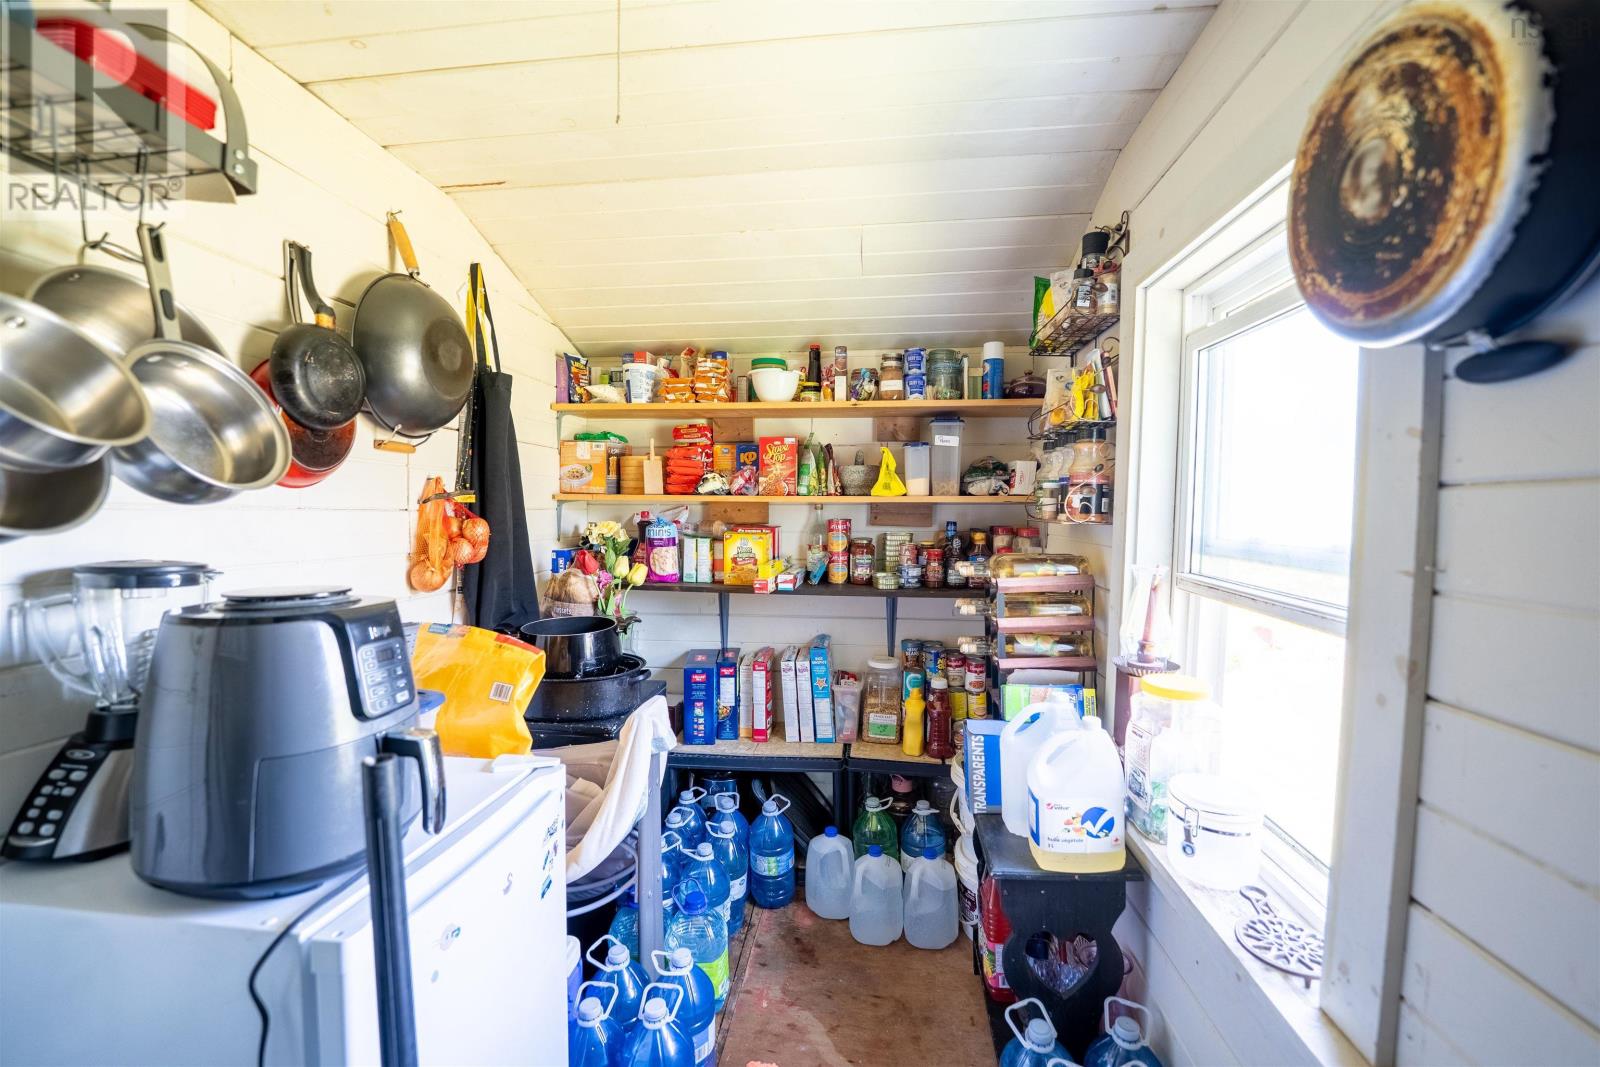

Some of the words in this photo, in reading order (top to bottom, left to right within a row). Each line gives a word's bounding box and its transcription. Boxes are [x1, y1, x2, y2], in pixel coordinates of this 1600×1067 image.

[762, 443, 789, 460] Stove
[770, 453, 786, 464] Top
[972, 735, 987, 814] TRANSPARENTS
